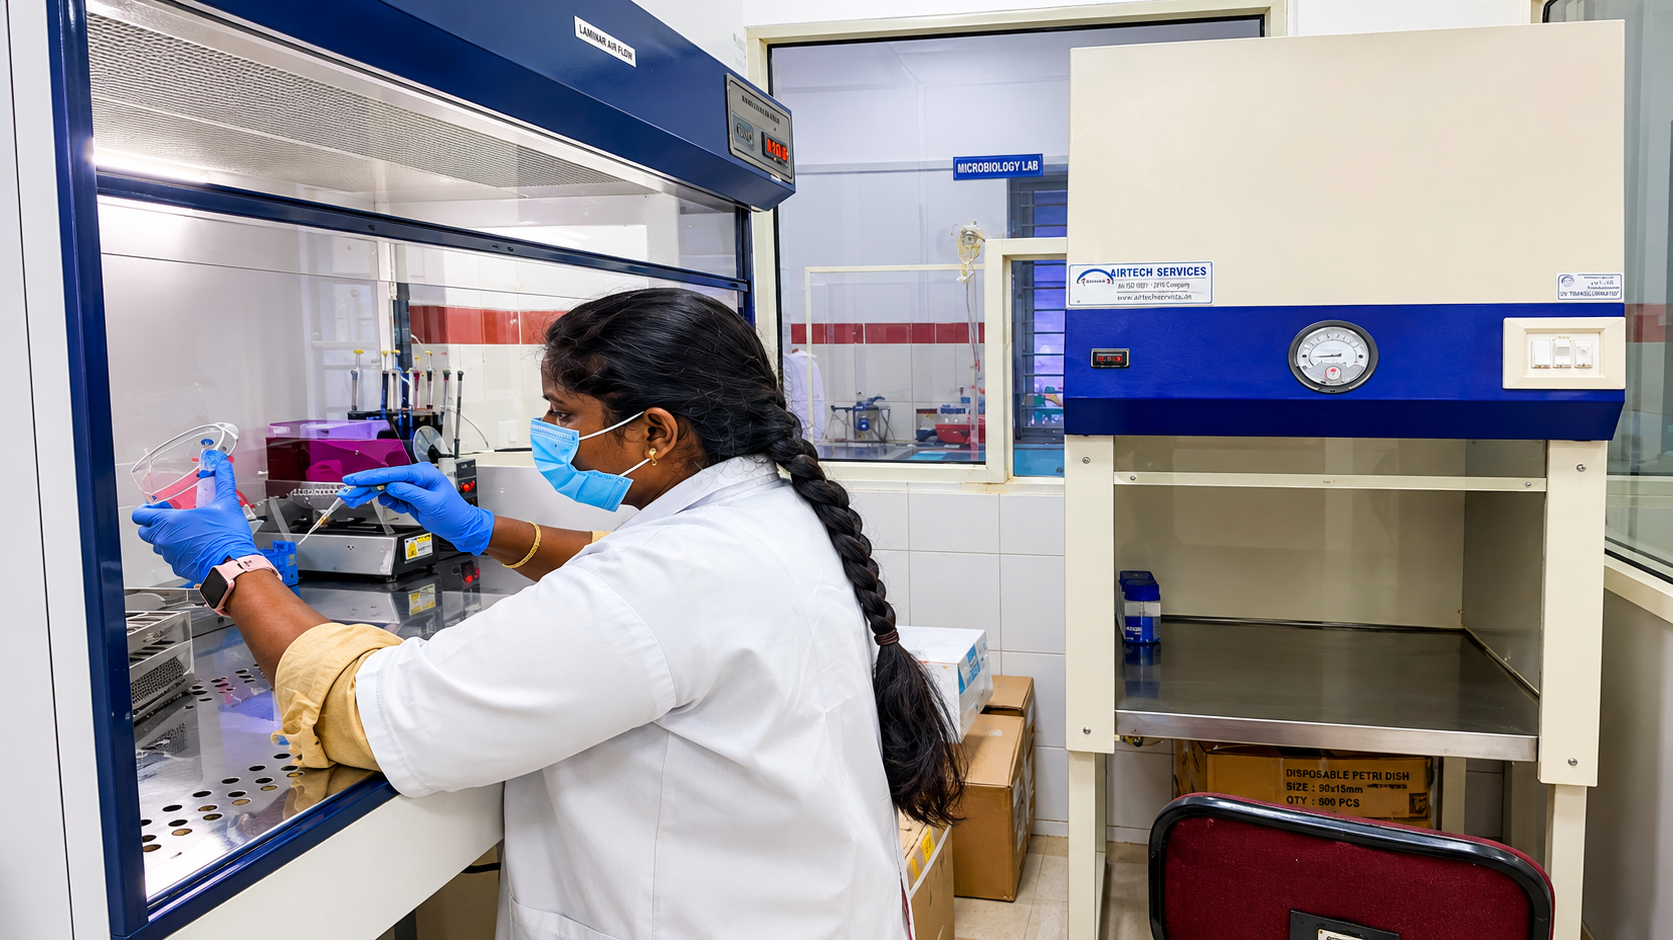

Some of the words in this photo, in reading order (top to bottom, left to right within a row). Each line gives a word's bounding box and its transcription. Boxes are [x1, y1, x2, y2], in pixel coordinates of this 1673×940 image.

[607, 40, 618, 53] AIR
[957, 161, 1020, 174] MICROBIOLOGY
[1022, 160, 1039, 171] LAB
[1111, 268, 1153, 278] AIRTECH
[1157, 266, 1207, 277] SERVICES
[1285, 768, 1350, 780] DISPOSABLE
[1352, 771, 1382, 781] PETRI
[1385, 772, 1410, 781] DISH
[1286, 782, 1308, 792] SIZE
[1286, 795, 1308, 805] QTY
[1339, 798, 1360, 808] PCS
